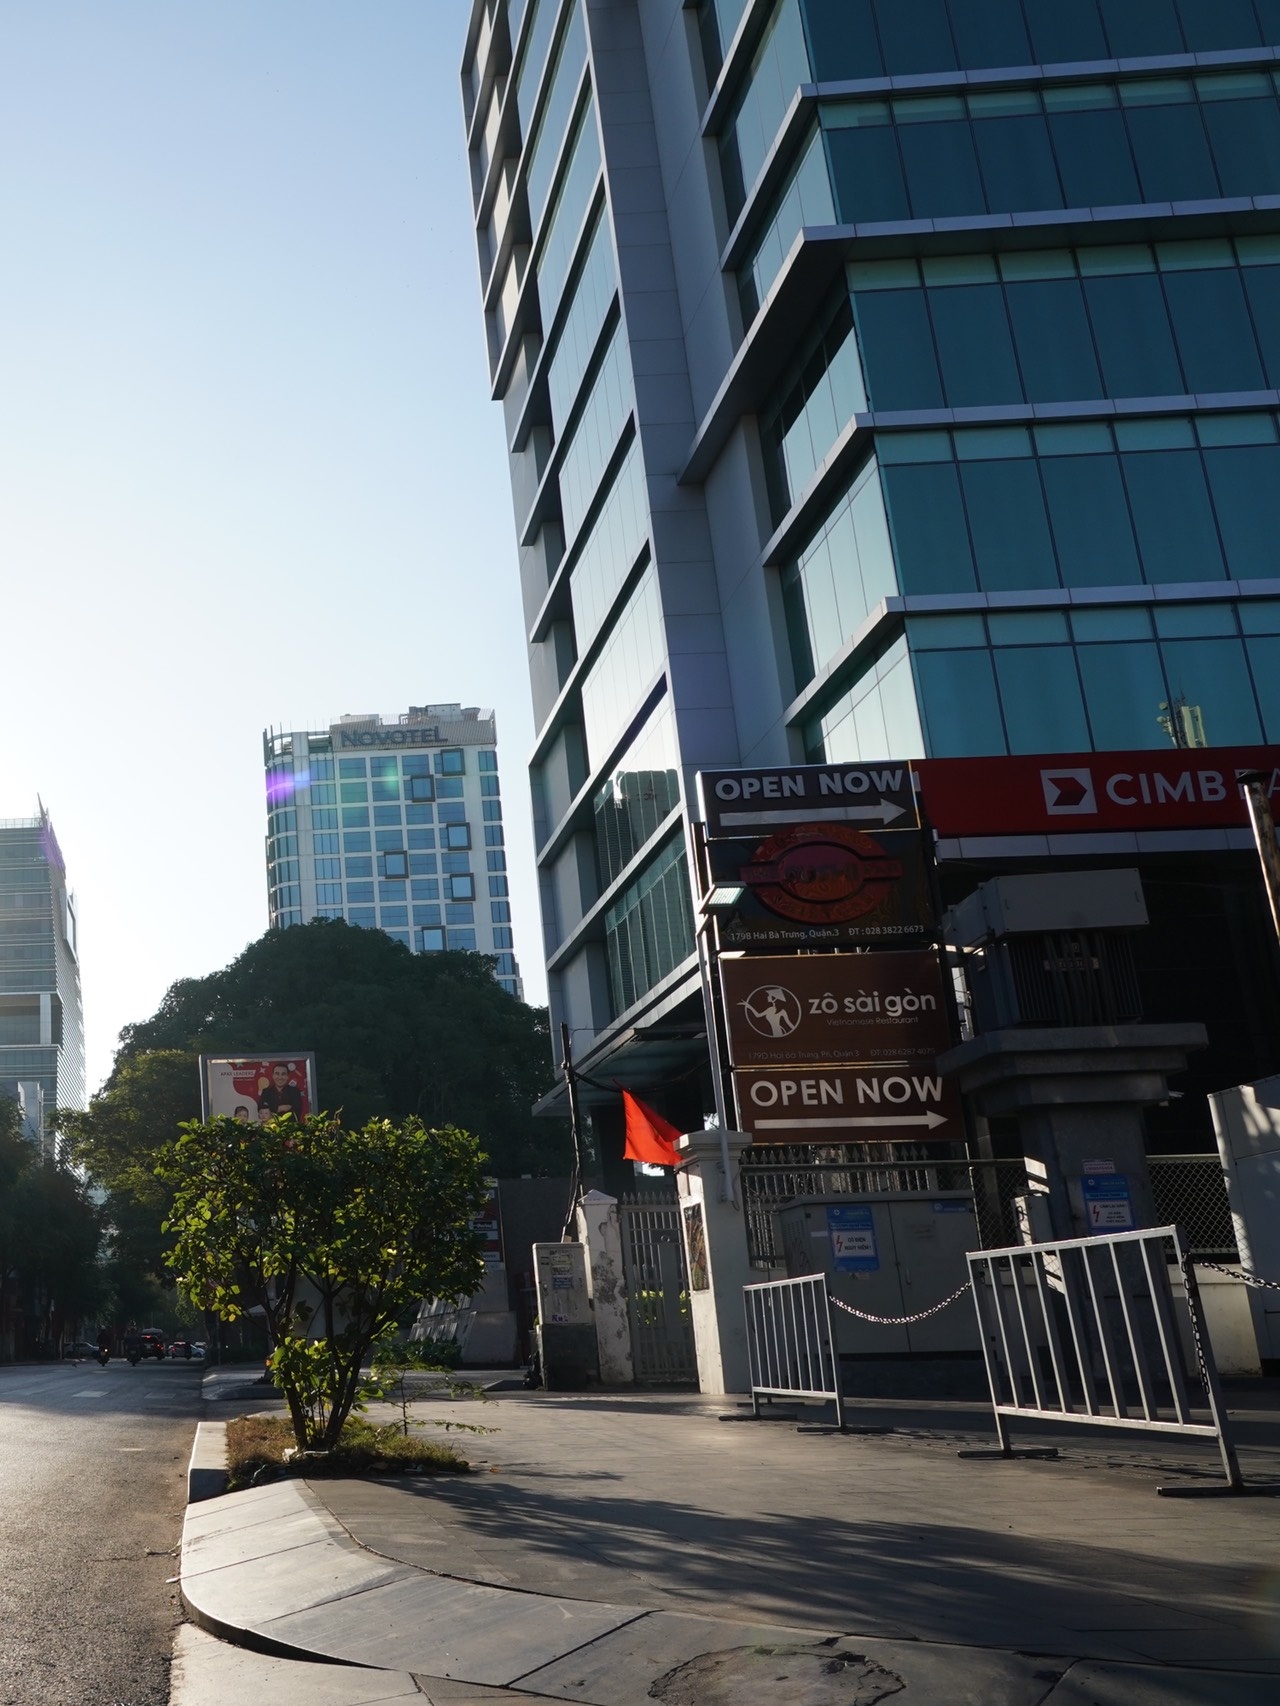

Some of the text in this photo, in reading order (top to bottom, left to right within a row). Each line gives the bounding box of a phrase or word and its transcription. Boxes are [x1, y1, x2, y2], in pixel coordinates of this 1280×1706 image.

[340, 725, 448, 747] NOVOTEL
[715, 769, 903, 801] OPEN NOW
[1106, 769, 1227, 806] CIMB
[753, 930, 768, 939] Hai
[769, 929, 780, 939] Bà
[865, 926, 881, 935] 028
[881, 925, 902, 934] 3822
[903, 924, 924, 933] 6673
[808, 987, 937, 1017] zô sài gòn
[826, 1015, 919, 1026] Vietnamese Restaurant
[750, 1076, 943, 1107] OPEN NOW
